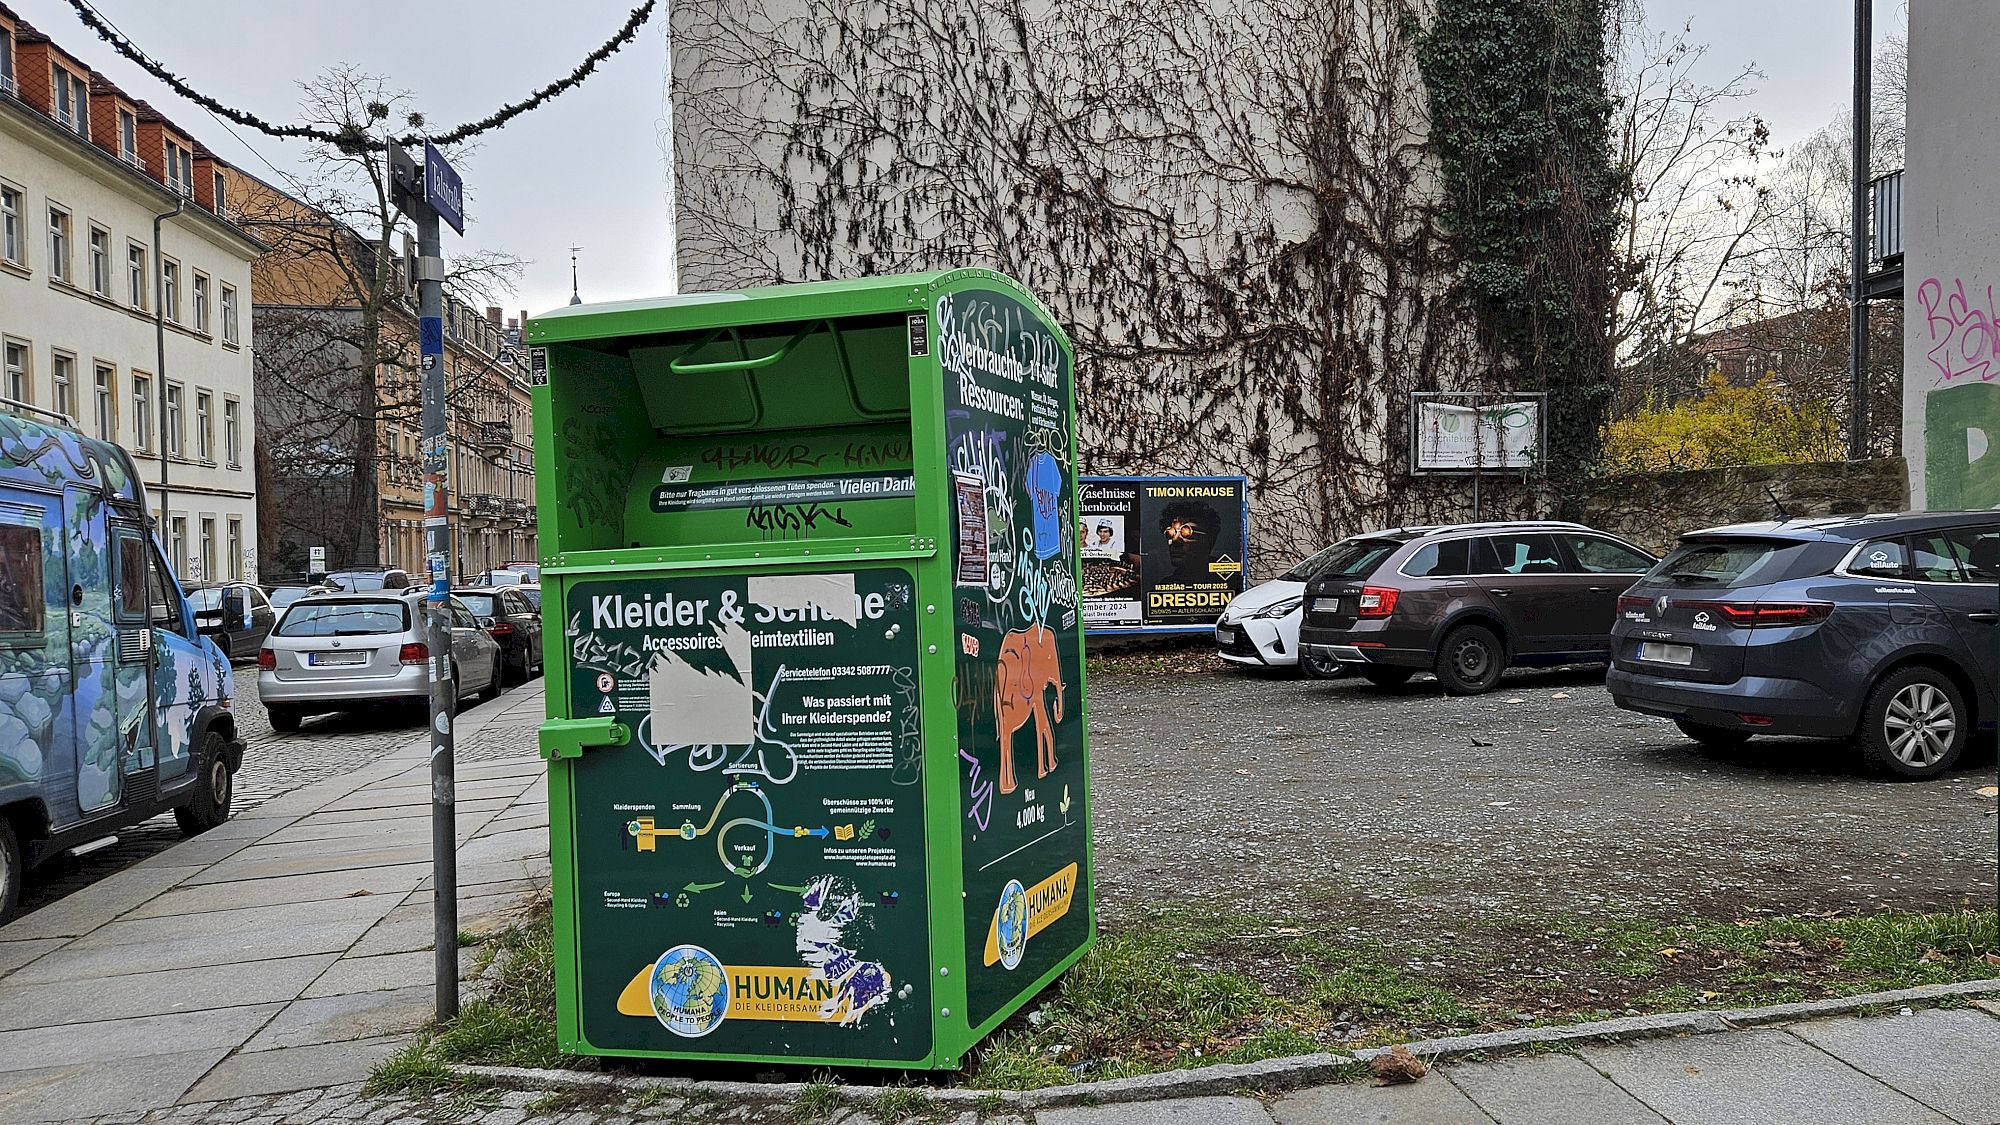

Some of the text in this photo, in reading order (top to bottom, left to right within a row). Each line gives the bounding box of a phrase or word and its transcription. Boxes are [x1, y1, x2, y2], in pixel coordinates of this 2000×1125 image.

[432, 161, 461, 217] Talstraße
[958, 331, 1023, 383] Verbrauchte
[960, 373, 1024, 420] Ressourcen:
[660, 491, 675, 499] Bitte
[688, 489, 718, 498] Tragbares
[727, 487, 737, 497] gut
[738, 484, 786, 494] verschlossenen
[787, 483, 805, 491] Tüten
[806, 481, 836, 491] spenden.
[840, 479, 879, 495] Vielen
[1146, 487, 1234, 497] TIMON KRAUSE
[1109, 603, 1127, 611] 2024
[1150, 592, 1232, 608] DRESDEN
[592, 592, 709, 629] Kleider
[718, 590, 746, 625] &
[643, 634, 722, 652] Accessoires
[781, 665, 890, 678] Servicetelefon 03342 5087777
[802, 694, 892, 709] Was passiert mit
[781, 711, 892, 725] Ihrer Kleiderspende?
[729, 762, 758, 770] Sortierung
[613, 803, 701, 811] Kleiderspenden Sammlung
[1016, 803, 1045, 829] 4.000 kg
[733, 844, 756, 852] Verkauf
[867, 847, 896, 855] Projekten:
[1028, 878, 1068, 919] HUMANA
[673, 1005, 707, 1015] HUMANA
[735, 1002, 751, 1011] DIE
[657, 1006, 722, 1024] PEOPLE TO PEOPLE
